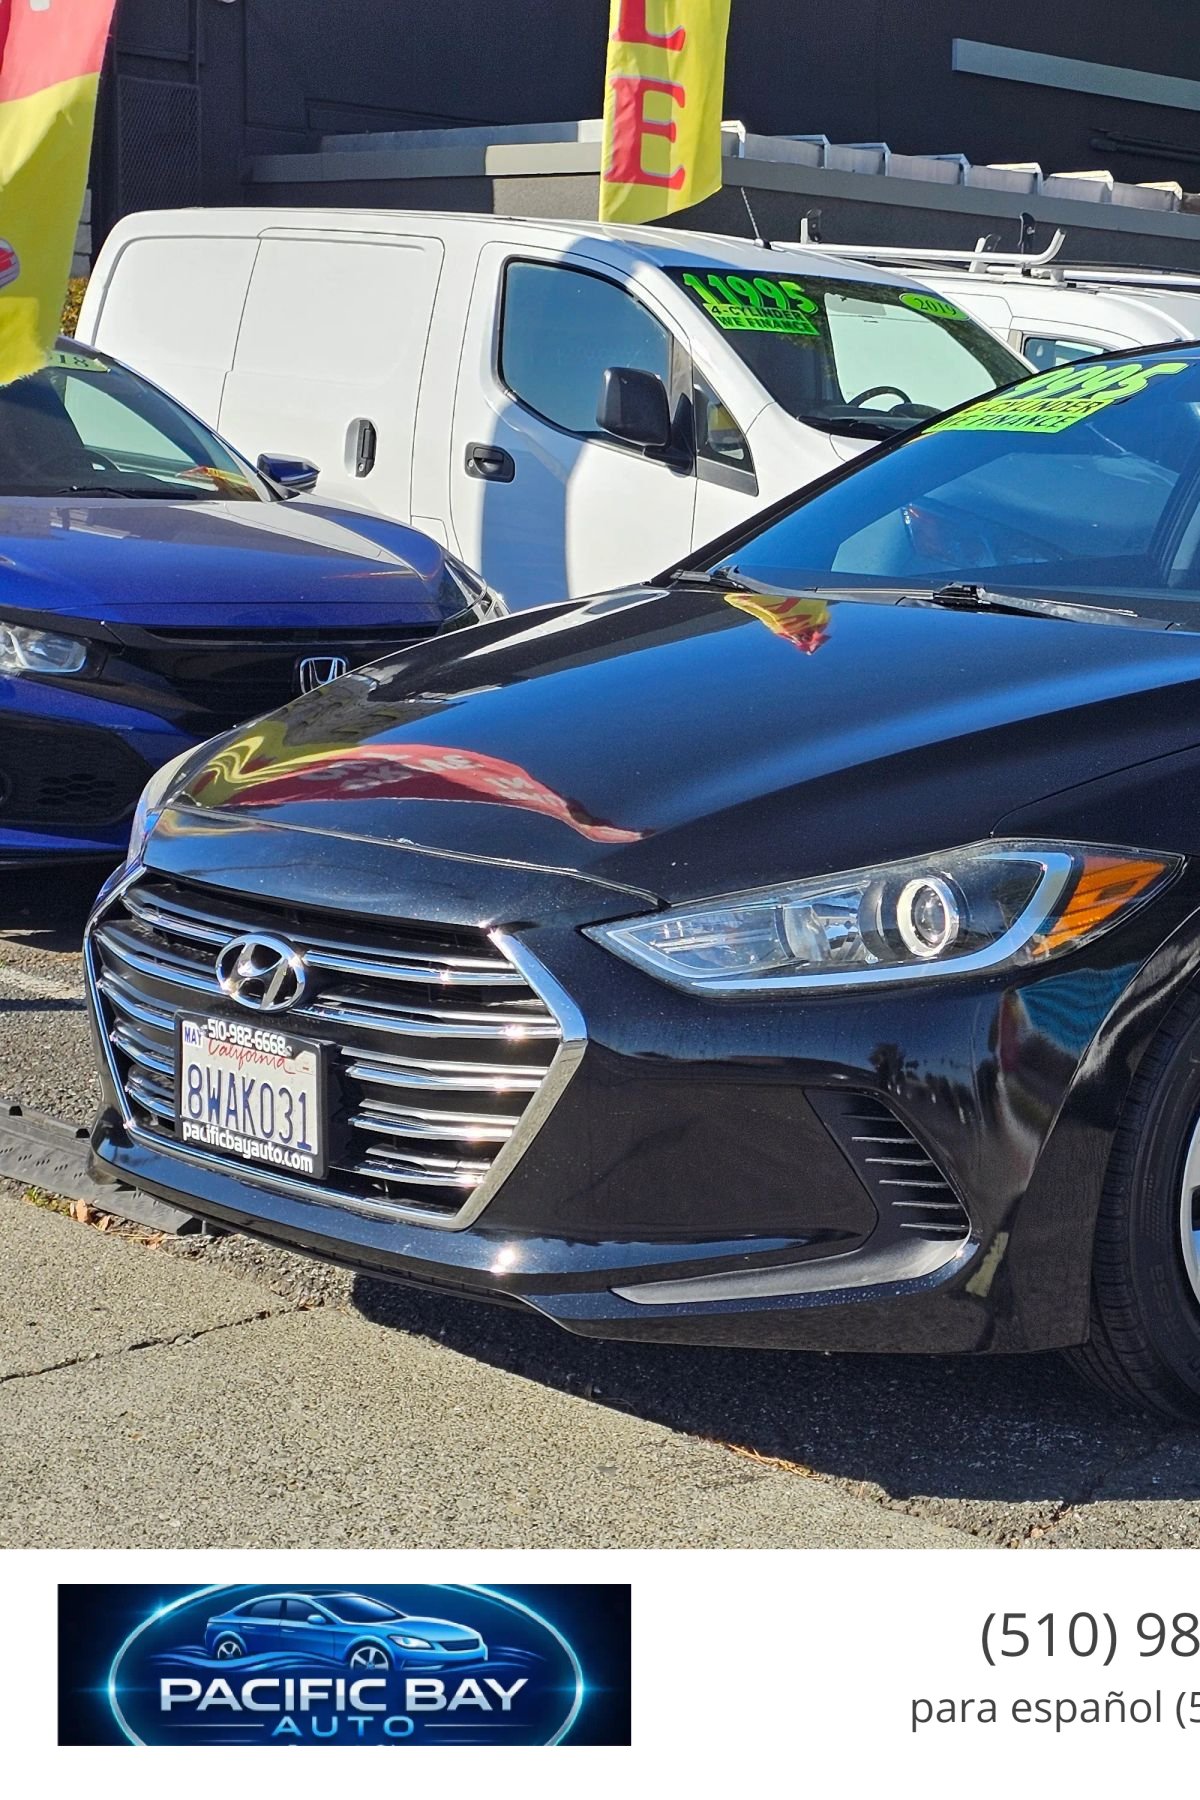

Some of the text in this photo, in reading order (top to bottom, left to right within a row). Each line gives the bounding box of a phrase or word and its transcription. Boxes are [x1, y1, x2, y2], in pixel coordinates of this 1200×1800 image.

[683, 273, 819, 314] 11995
[914, 298, 957, 316] 2019
[711, 305, 803, 320] 4-CYLINDER
[717, 316, 814, 333] WE FINANCE
[972, 414, 1080, 429] FINANCE
[208, 1018, 286, 1057] 510-982-6668
[187, 1063, 312, 1151] 8WAK031
[182, 1121, 314, 1174] pacificbayauto.com
